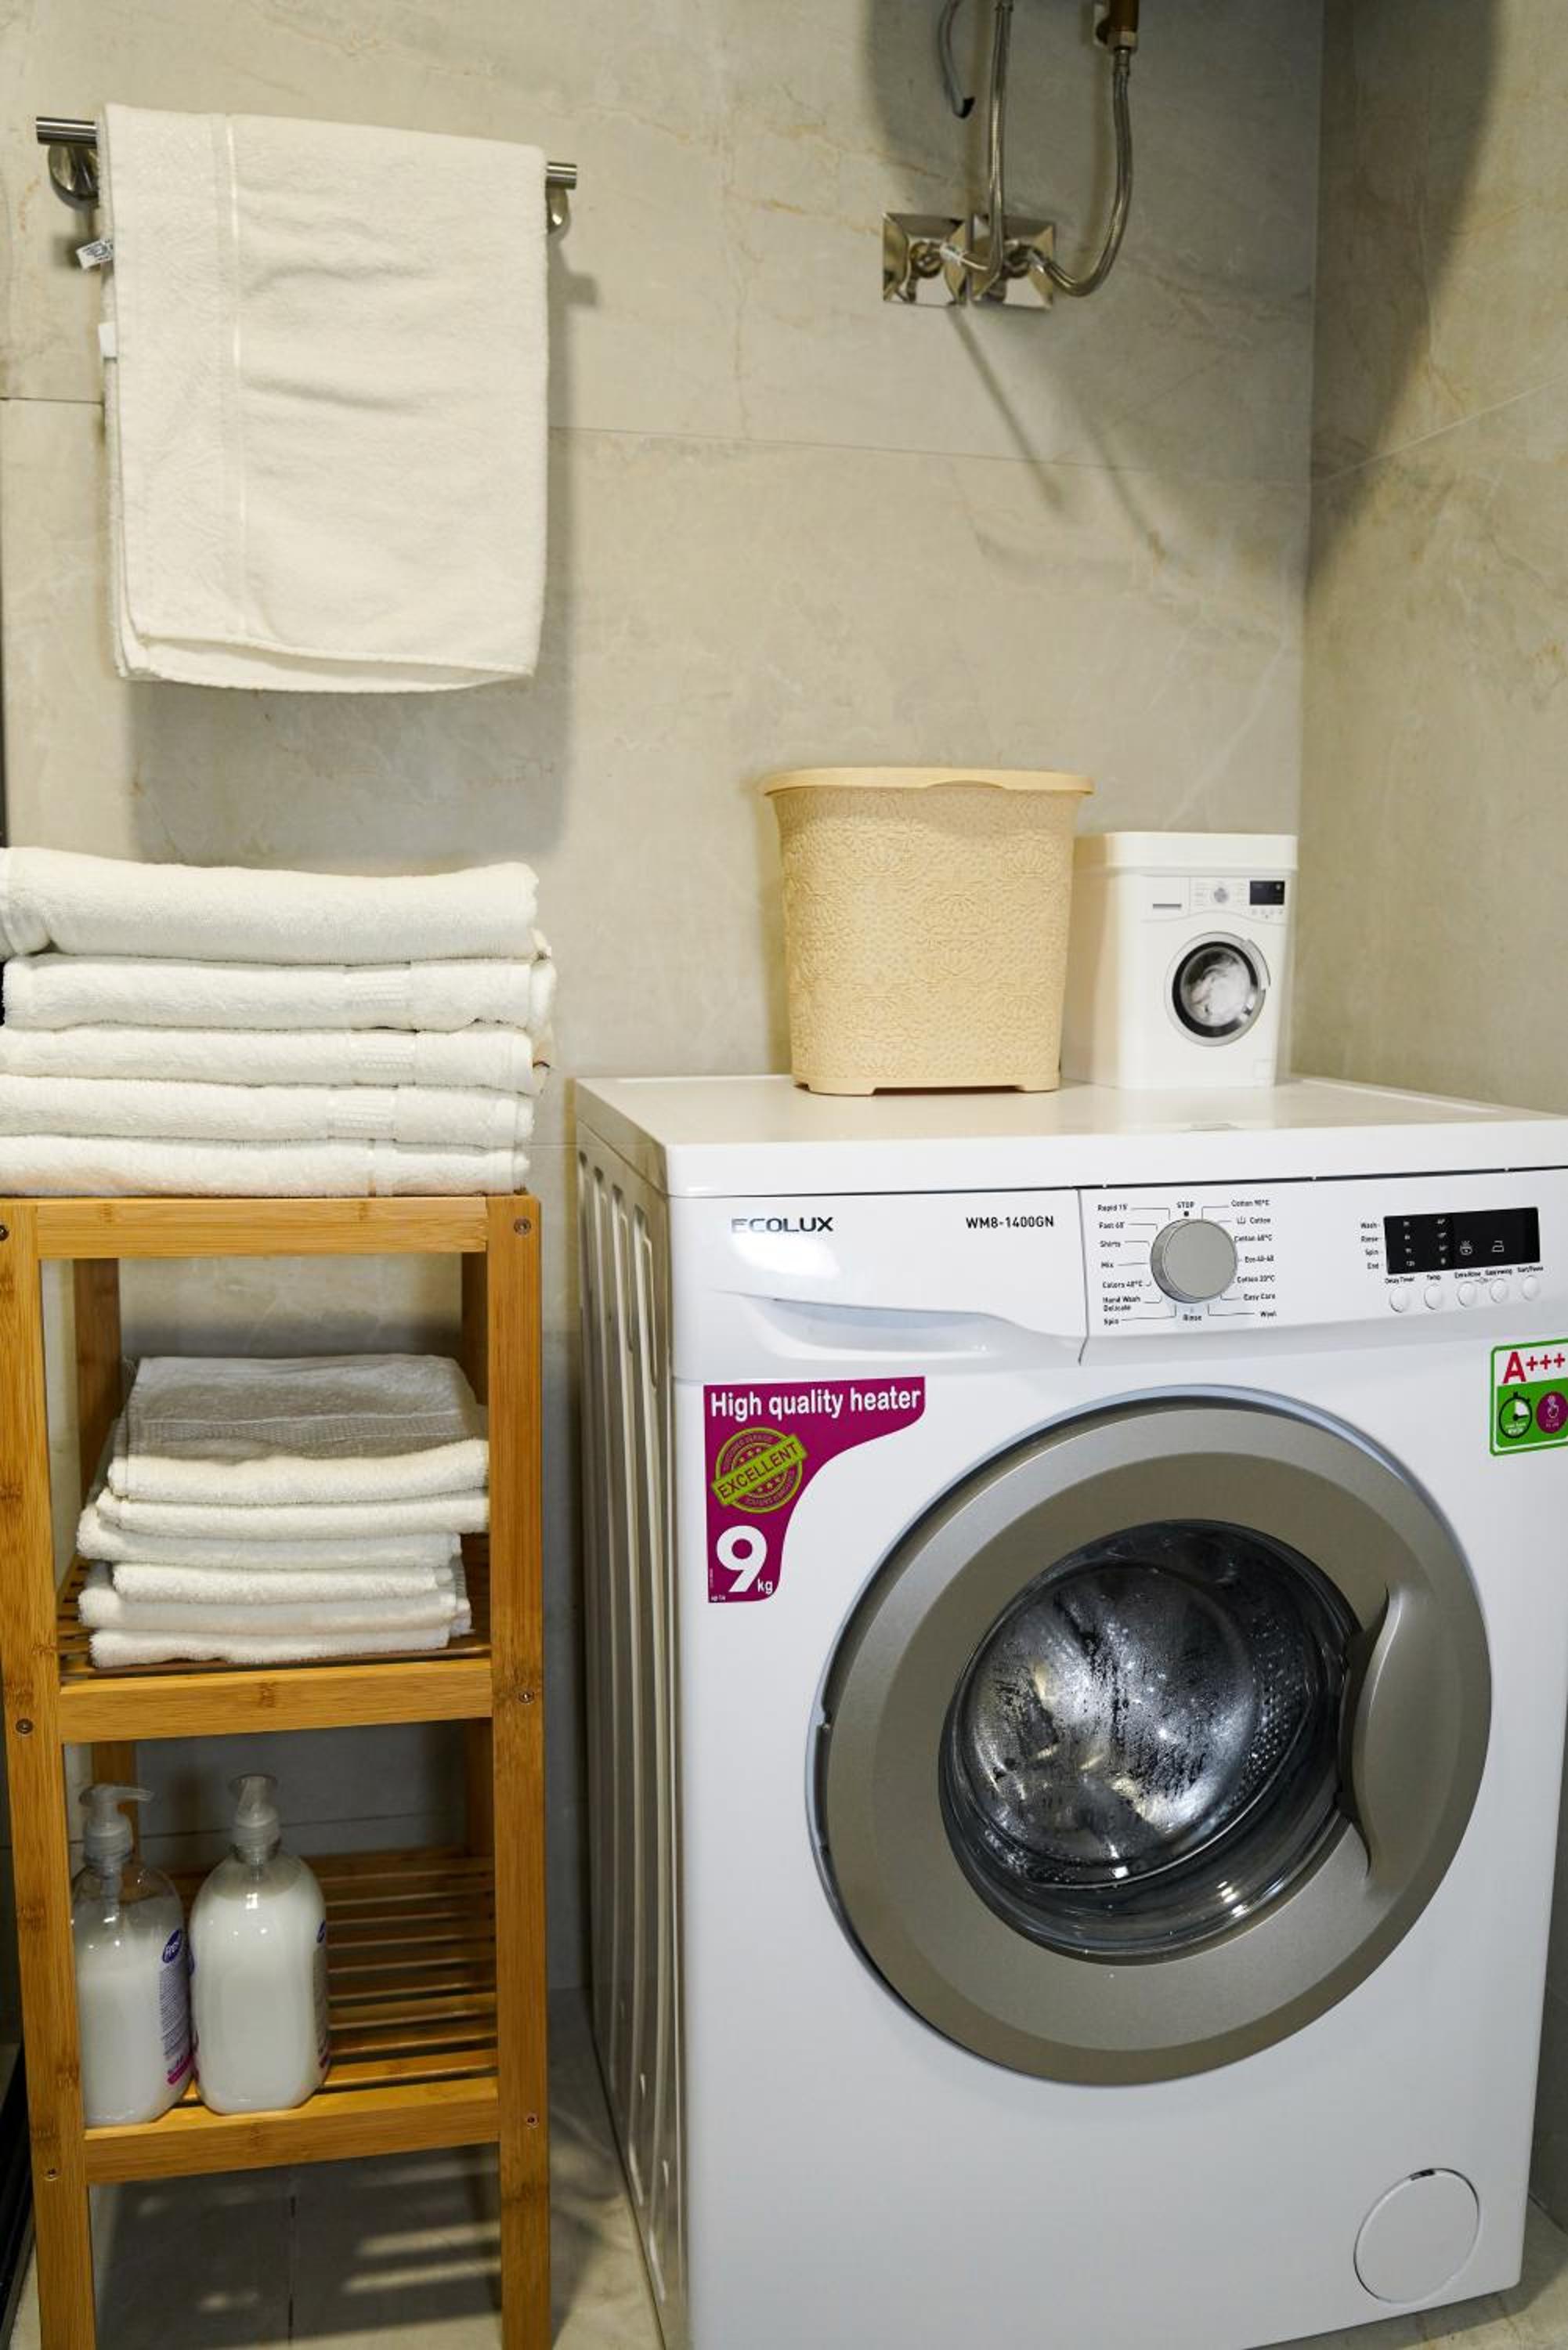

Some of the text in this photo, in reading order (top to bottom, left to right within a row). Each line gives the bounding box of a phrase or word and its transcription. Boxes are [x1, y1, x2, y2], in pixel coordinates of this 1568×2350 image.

[731, 1217, 833, 1232] ECOLUX
[966, 1216, 1054, 1229] WM8-1400GN
[1502, 1351, 1565, 1383] A+++
[711, 1386, 921, 1422] High quality heater
[717, 1442, 798, 1499] EXCELLENT
[716, 1525, 768, 1593] 9
[757, 1578, 773, 1594] kg
